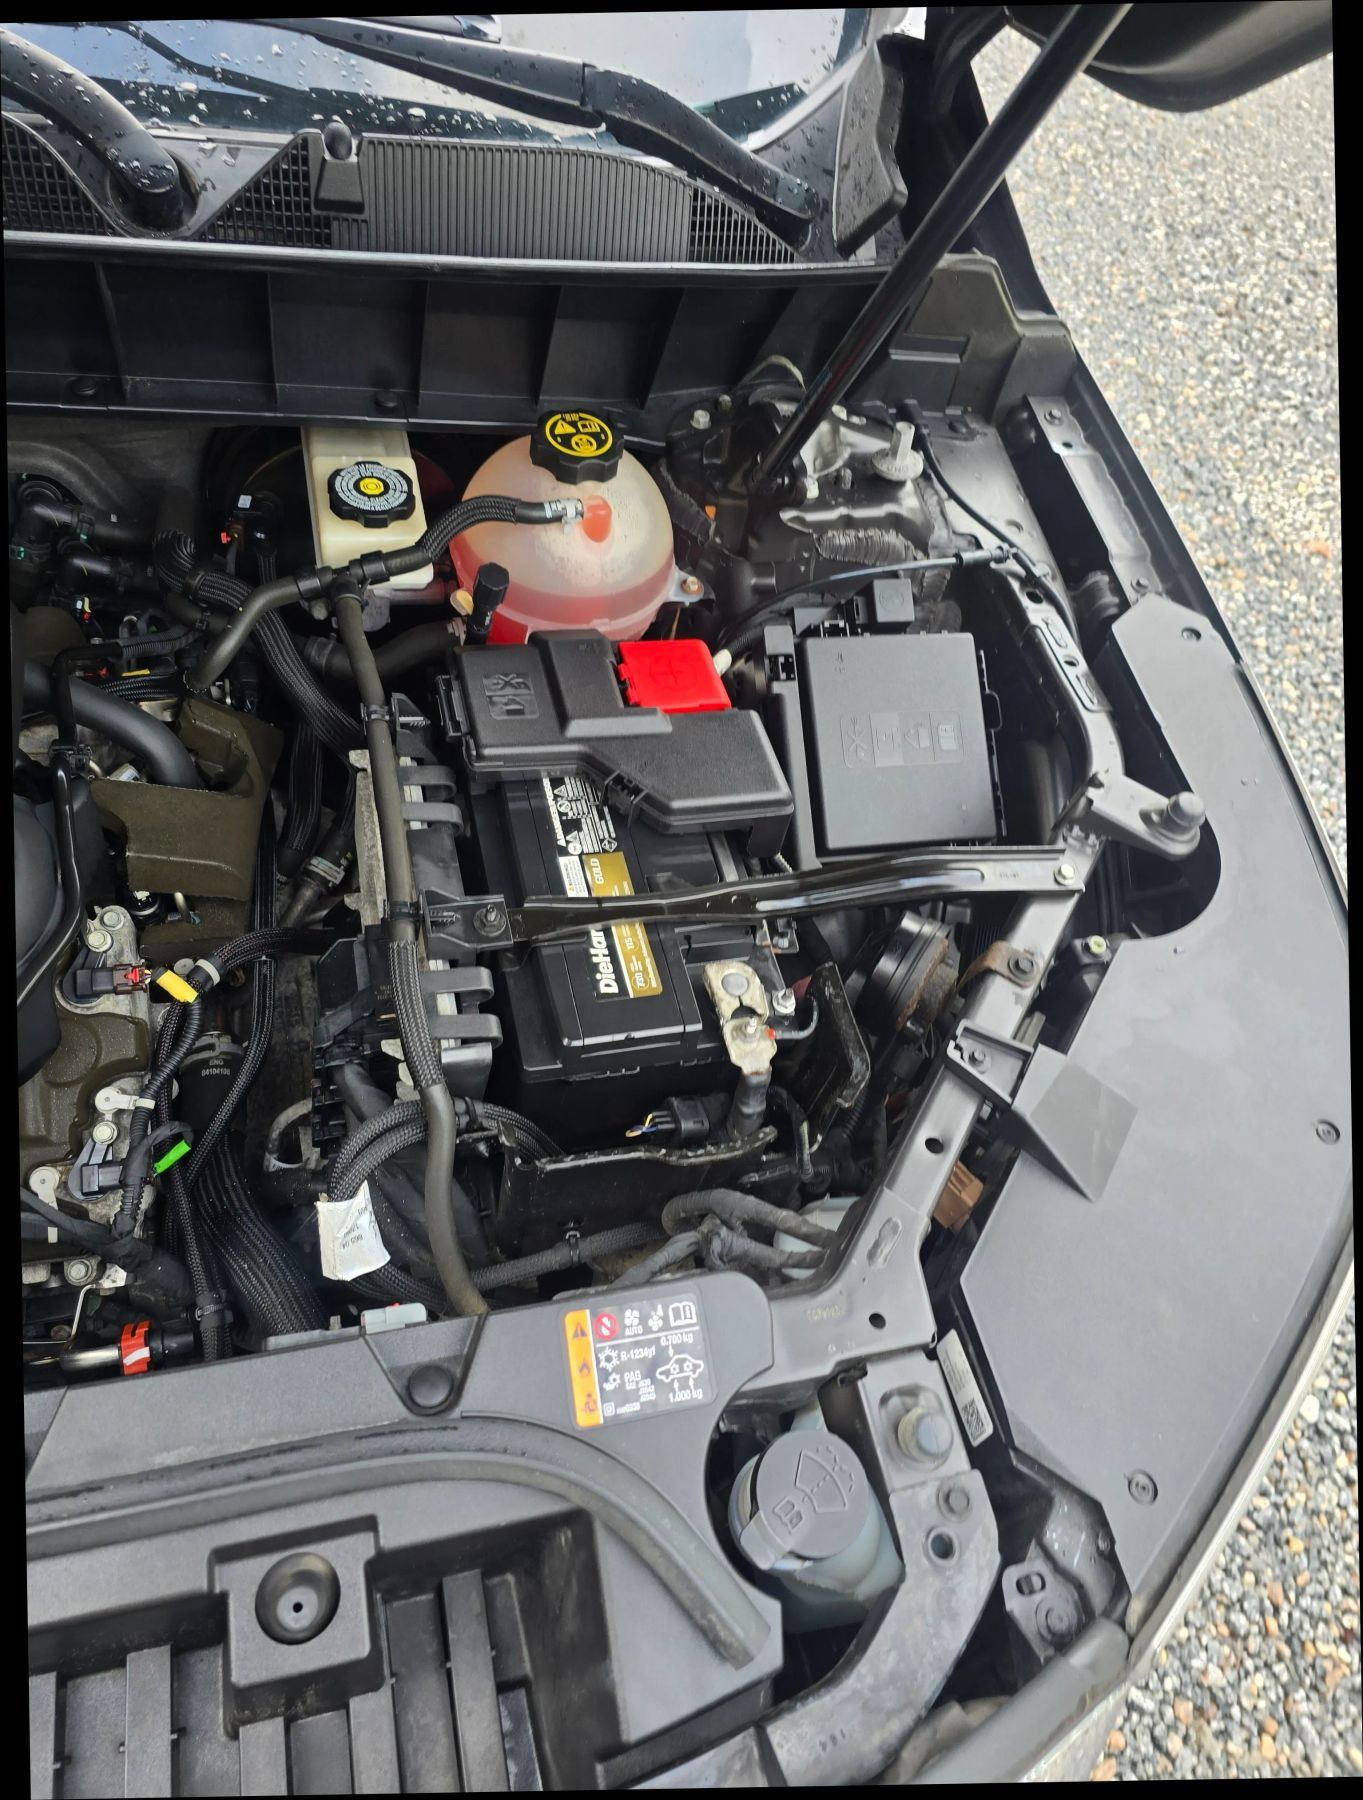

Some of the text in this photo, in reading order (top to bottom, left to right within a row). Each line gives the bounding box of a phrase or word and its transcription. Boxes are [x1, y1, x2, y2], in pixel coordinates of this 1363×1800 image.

[590, 858, 605, 885] GOLD
[590, 927, 619, 994] DieHar
[625, 1326, 643, 1336] AUTO
[660, 1333, 694, 1347] 0.700 kg
[620, 1345, 656, 1361] R-1234yf
[624, 1370, 642, 1381] PAG
[669, 1388, 704, 1404] 1.000 kg
